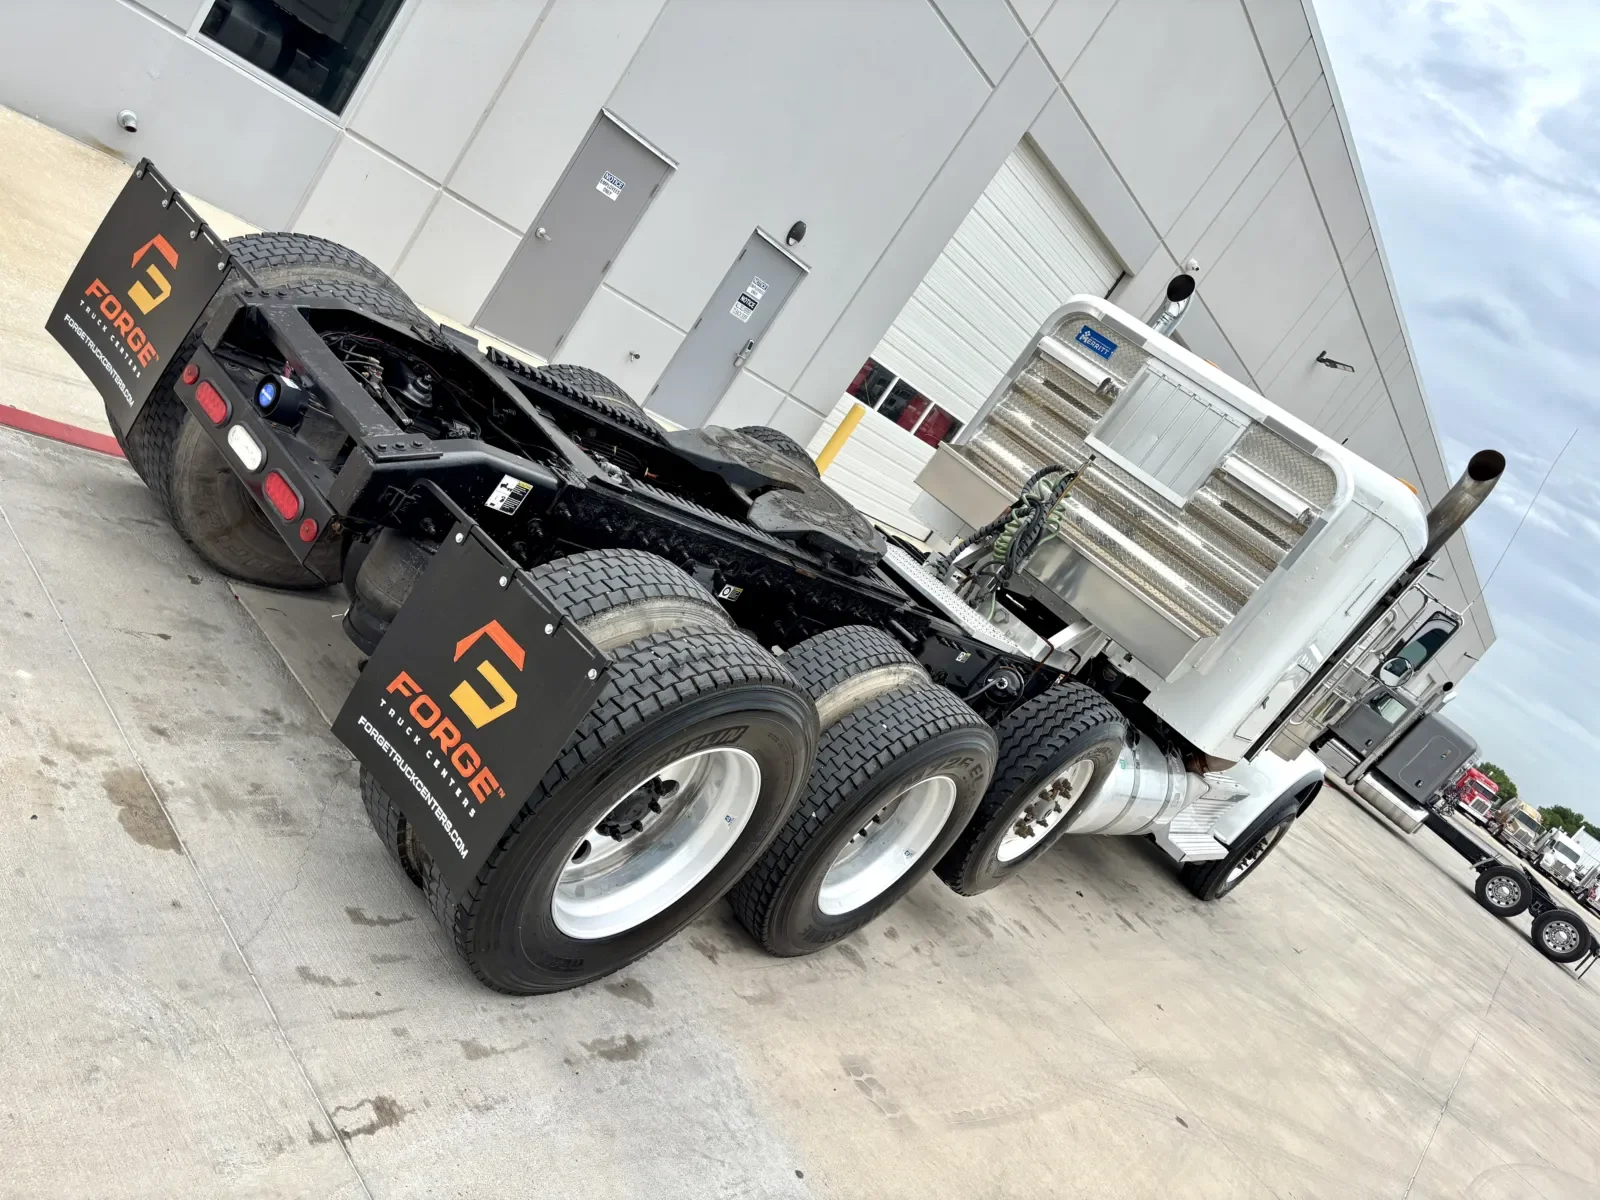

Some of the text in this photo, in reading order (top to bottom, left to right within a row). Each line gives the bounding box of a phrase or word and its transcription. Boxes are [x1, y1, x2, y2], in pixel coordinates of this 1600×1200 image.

[603, 172, 624, 188] NOTICE
[63, 314, 135, 407] FORGETRUCKCENTERS.COM
[79, 299, 141, 378] TRUCK CENTERS
[84, 278, 157, 368] FORGE
[1079, 334, 1109, 354] MERRITT
[379, 698, 476, 818] TRUCK CENTERS
[385, 670, 499, 804] FORGE
[357, 715, 469, 859] FORGETRUCKCENTERS.COM
